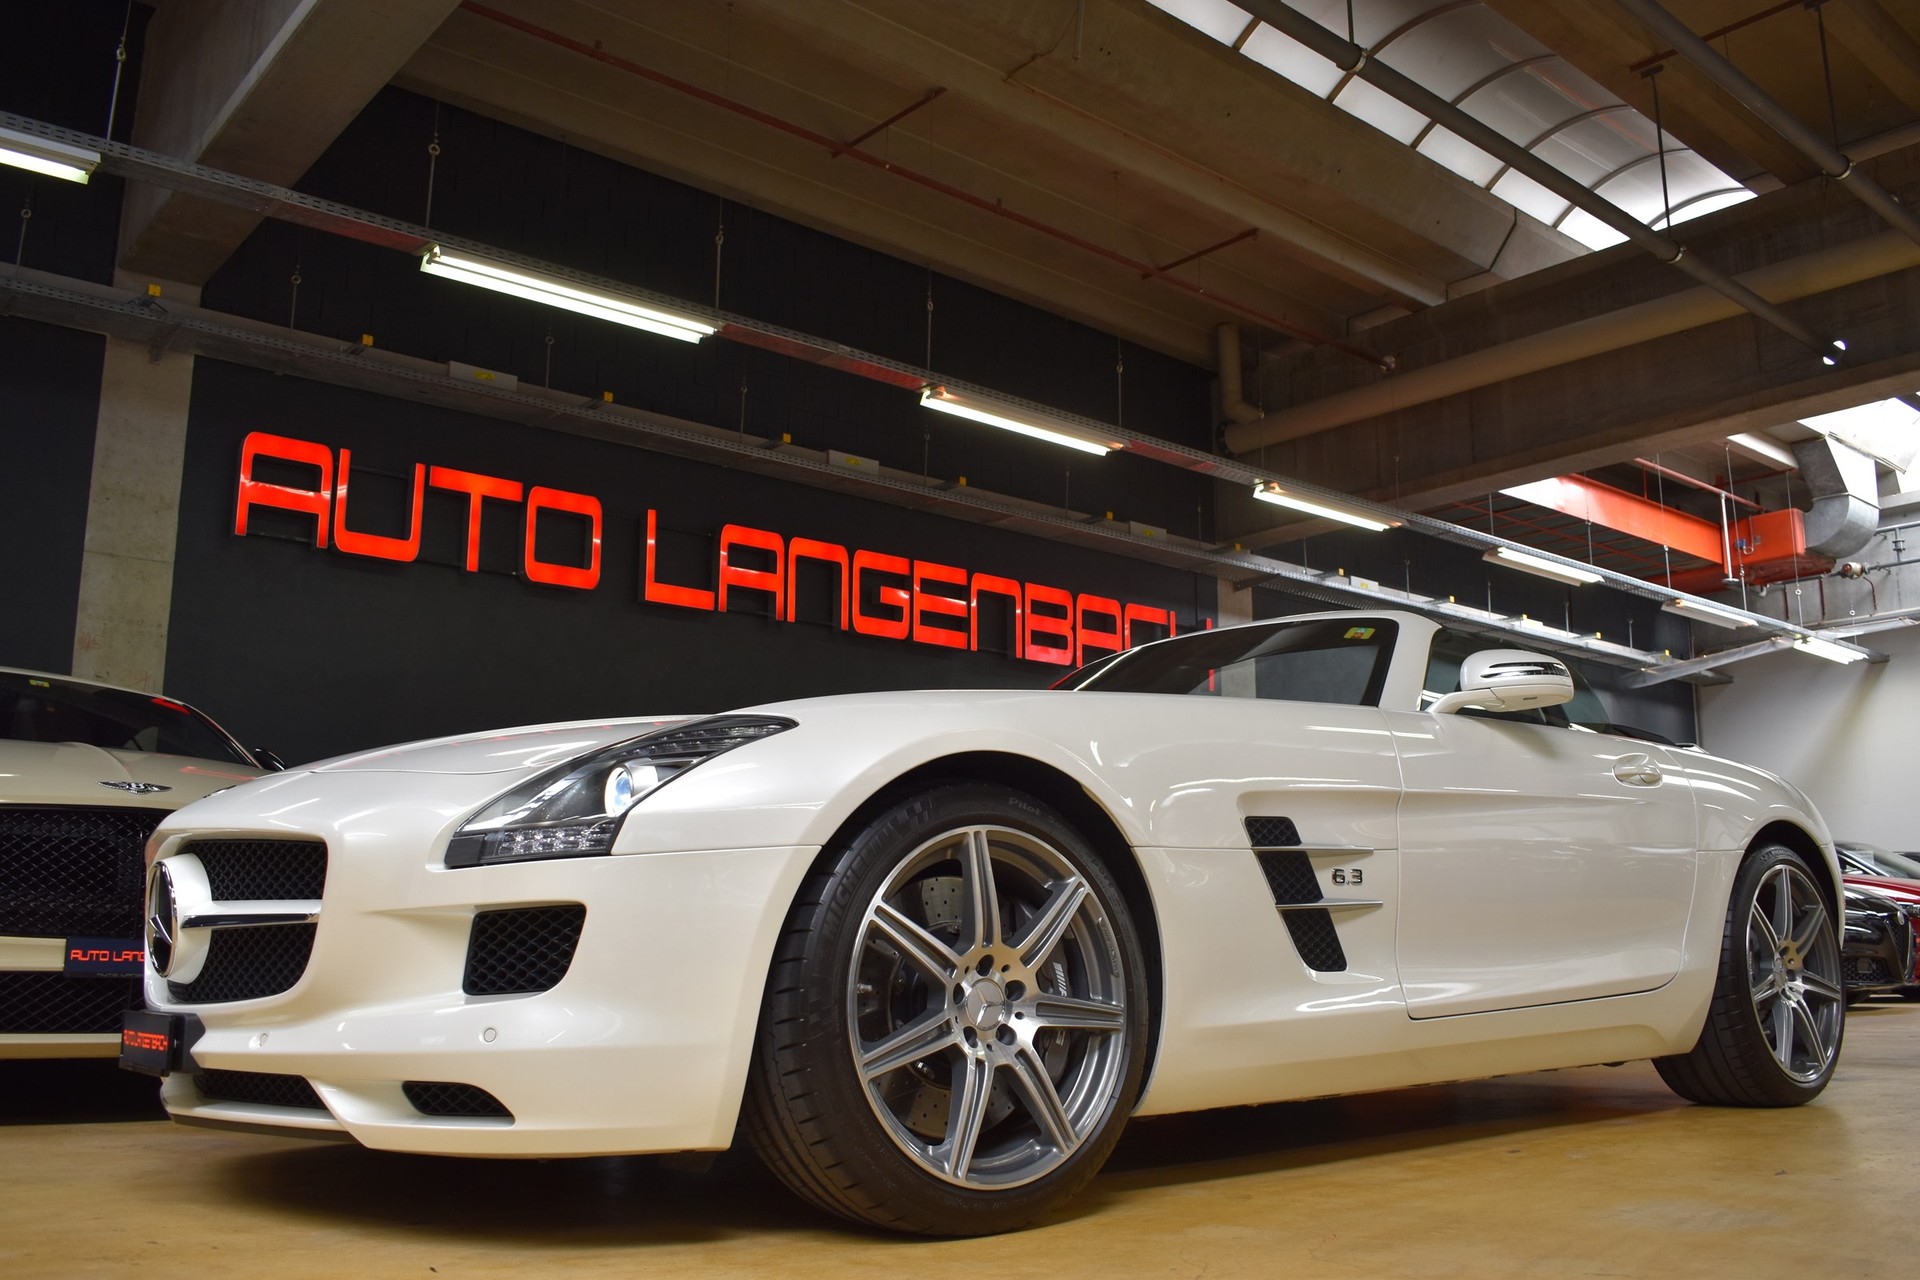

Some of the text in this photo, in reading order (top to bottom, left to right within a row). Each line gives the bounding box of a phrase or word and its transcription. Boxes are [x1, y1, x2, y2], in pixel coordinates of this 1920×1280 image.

[234, 431, 603, 590] AUTO
[1008, 795, 1042, 816] Pilot
[823, 820, 895, 941] MICHELIN
[70, 949, 145, 963] AUTO LANG
